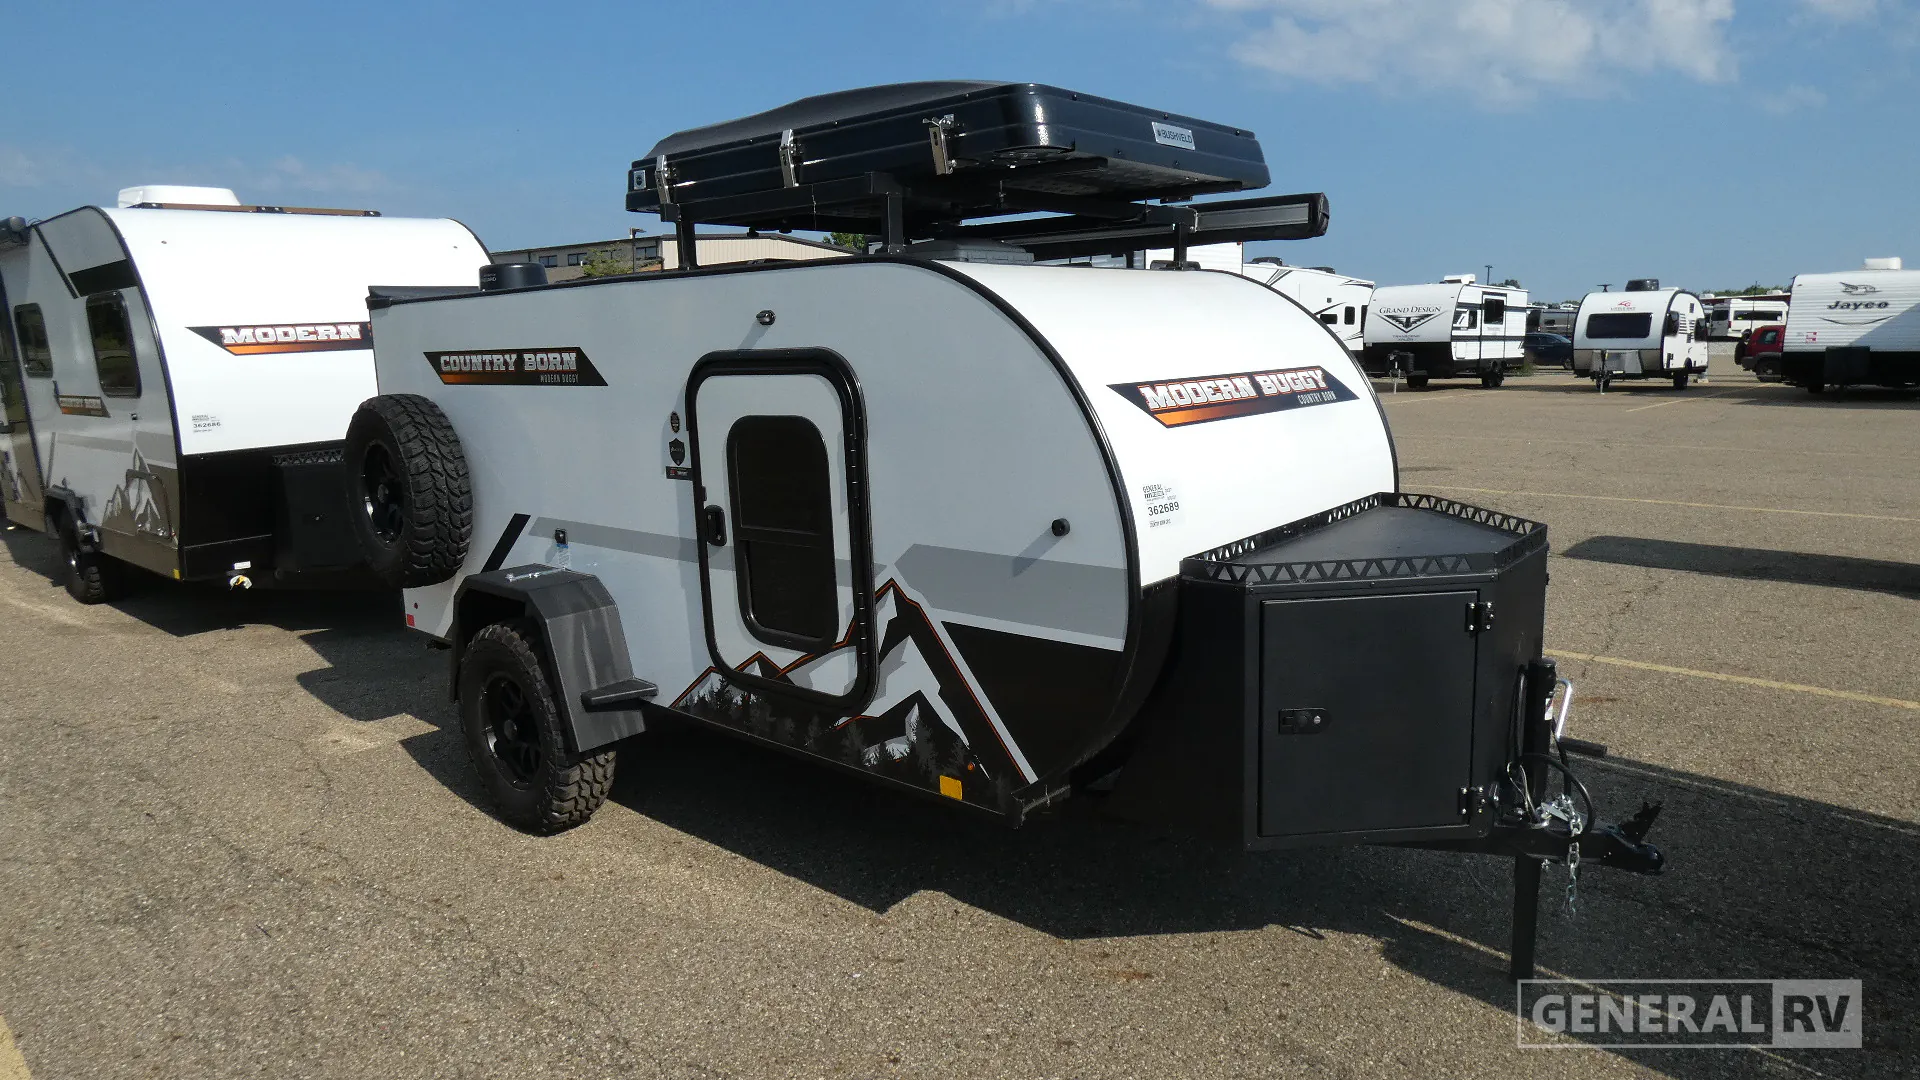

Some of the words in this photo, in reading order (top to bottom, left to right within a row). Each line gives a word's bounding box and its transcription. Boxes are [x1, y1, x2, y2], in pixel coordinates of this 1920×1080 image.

[1379, 306, 1410, 314] GRAND
[1410, 305, 1441, 313] DESIGN
[1827, 300, 1890, 310] Jayco
[219, 323, 362, 345] MODERN
[440, 353, 518, 372] COUNTRY
[523, 351, 577, 371] BORN
[1137, 375, 1259, 411] MODERN
[1253, 368, 1328, 397] BUGGY
[1297, 391, 1323, 405] COUNTRY
[1323, 390, 1337, 401] BORN
[1147, 501, 1180, 517] 362689
